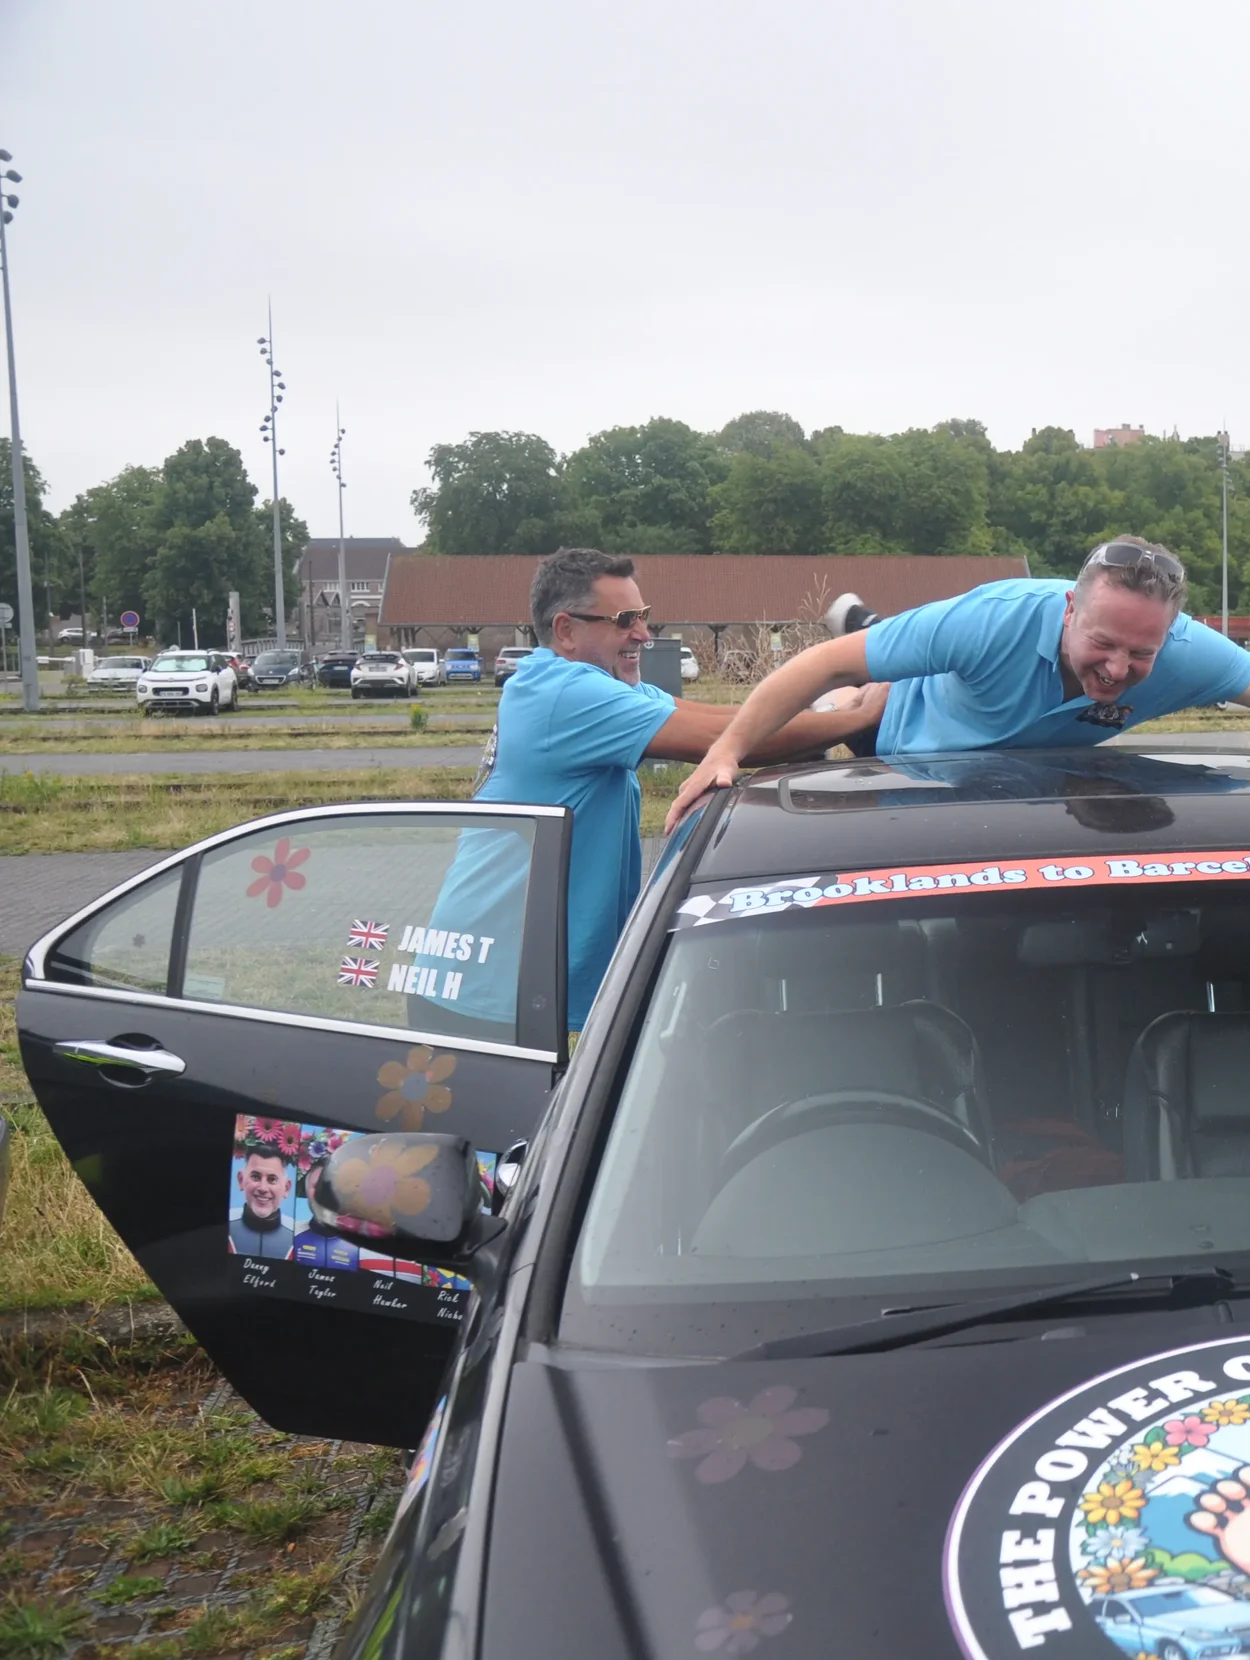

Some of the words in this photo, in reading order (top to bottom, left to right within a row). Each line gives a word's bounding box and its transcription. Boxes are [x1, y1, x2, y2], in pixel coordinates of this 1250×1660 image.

[728, 865, 1028, 914] Brooklands
[1038, 863, 1095, 882] to
[397, 925, 474, 961] JAMES
[477, 936, 495, 964] T
[387, 963, 438, 997] NEIL
[441, 971, 463, 1000] H
[243, 1258, 270, 1275] Danny
[243, 1274, 276, 1288] Elford
[308, 1268, 335, 1282] James
[309, 1285, 336, 1299] Taylor
[373, 1279, 393, 1290] Neil
[373, 1294, 408, 1309] Hawker
[437, 1290, 460, 1303] Rick
[437, 1307, 463, 1321] Nicho
[1008, 1370, 1217, 1518] POWER
[999, 1528, 1073, 1650] THE
